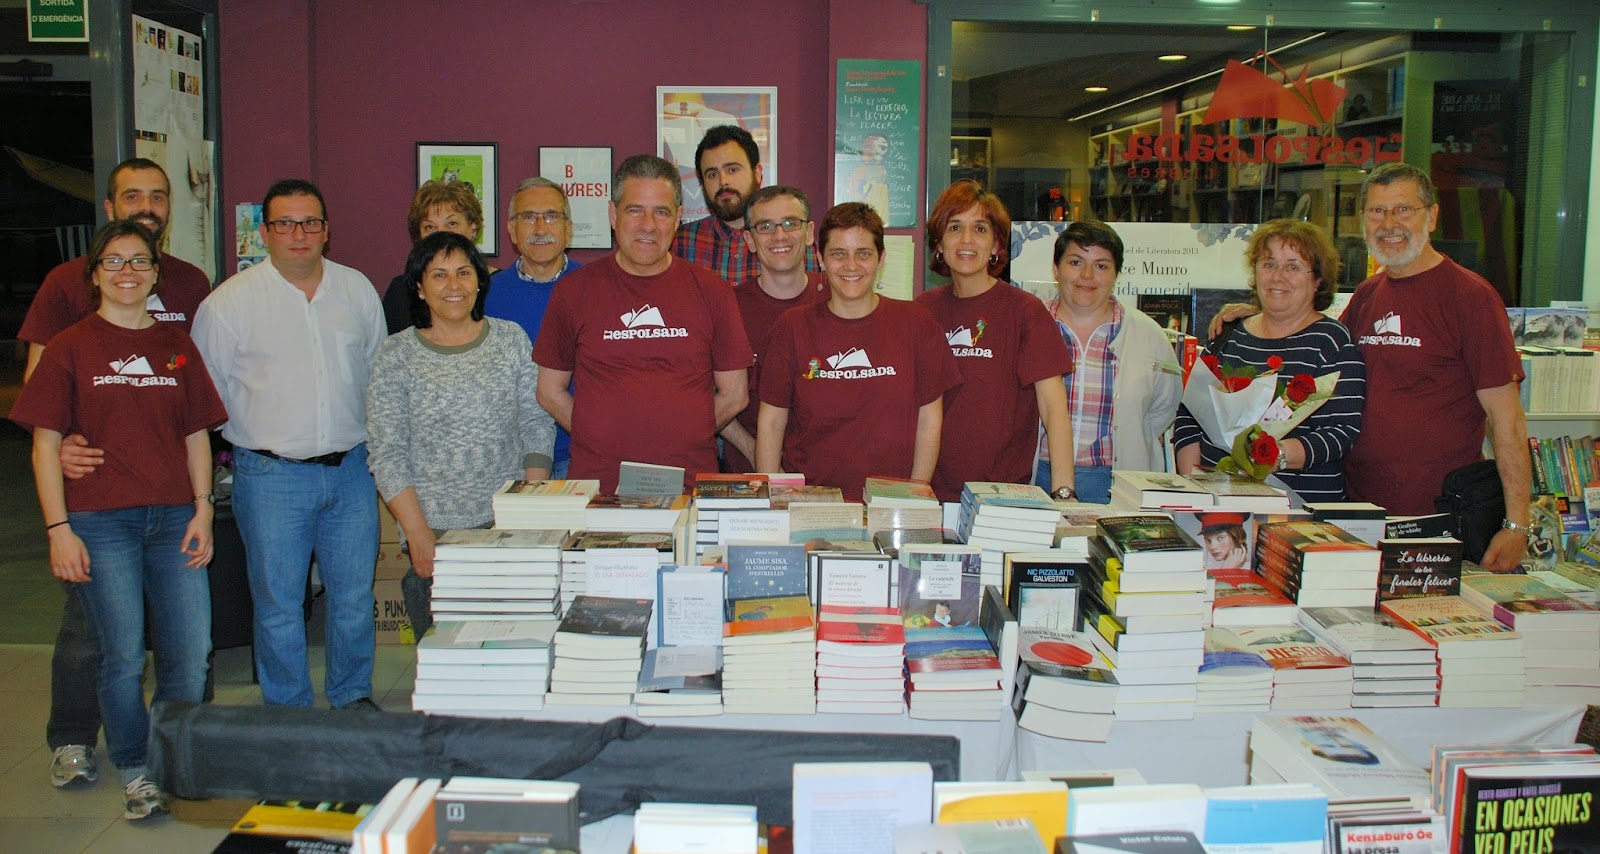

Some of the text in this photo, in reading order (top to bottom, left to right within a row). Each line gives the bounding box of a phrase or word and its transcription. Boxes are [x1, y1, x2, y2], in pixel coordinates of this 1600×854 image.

[565, 164, 574, 178] B
[1135, 246, 1145, 255] de
[1146, 246, 1181, 255] Literatura
[1182, 247, 1199, 255] 2013
[1119, 261, 1188, 276] ce Munro
[1144, 282, 1191, 296] querid
[1397, 522, 1418, 530] Grafton
[1405, 527, 1422, 535] whisky
[1397, 550, 1414, 562] La
[1038, 568, 1075, 576] PIZZOLATTO
[1032, 575, 1068, 583] GALVESTON
[1389, 573, 1458, 594] finales felices
[1476, 792, 1592, 832] EN OCASIONES
[1474, 827, 1555, 854] VEO PELIS
[1348, 846, 1399, 854] La presa
